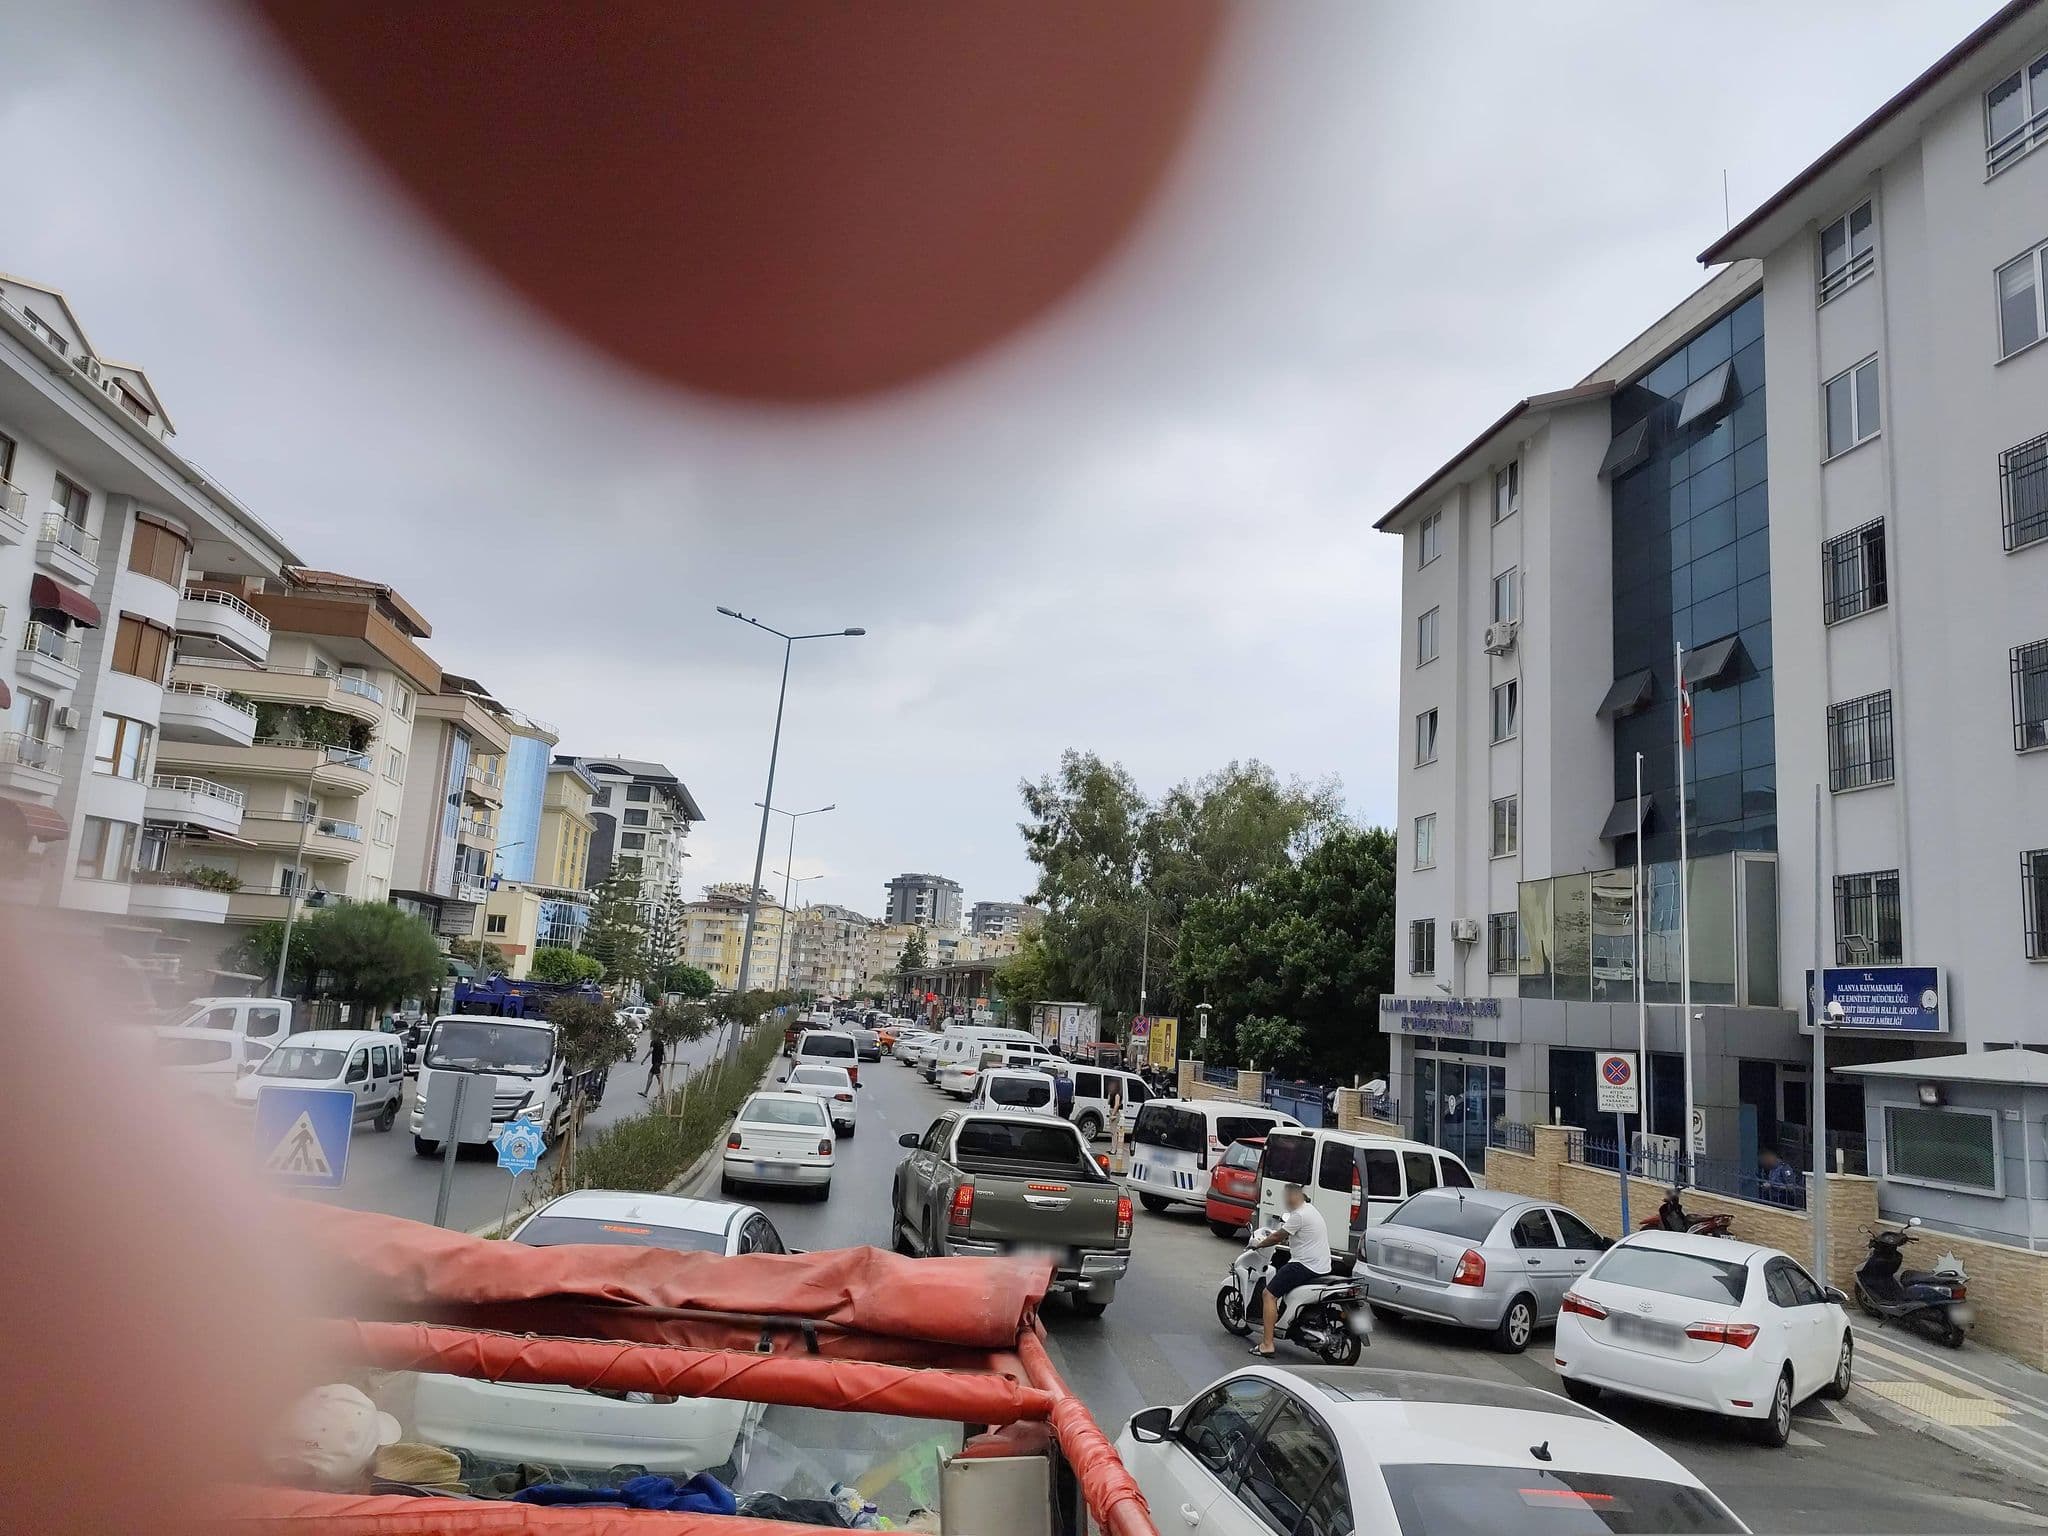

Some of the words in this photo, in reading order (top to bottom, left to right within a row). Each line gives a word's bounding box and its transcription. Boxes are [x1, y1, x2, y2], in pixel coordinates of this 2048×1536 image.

[1863, 973, 1874, 981] T.C.
[1837, 984, 1859, 992] ALANYA
[1860, 983, 1903, 992] KAYMAKAMLIĞI
[1832, 994, 1844, 1003] İLÇE
[1845, 994, 1871, 1003] EMNİYET
[1871, 994, 1909, 1003] MÜDÜRLÜĞÜ
[1857, 1004, 1880, 1013] İBRAHİM
[1881, 1005, 1898, 1014] HALİL
[1899, 1007, 1919, 1015] AKSOY
[1851, 1015, 1876, 1024] MERKEZİ
[1876, 1016, 1903, 1026] AMİRLİĞİ
